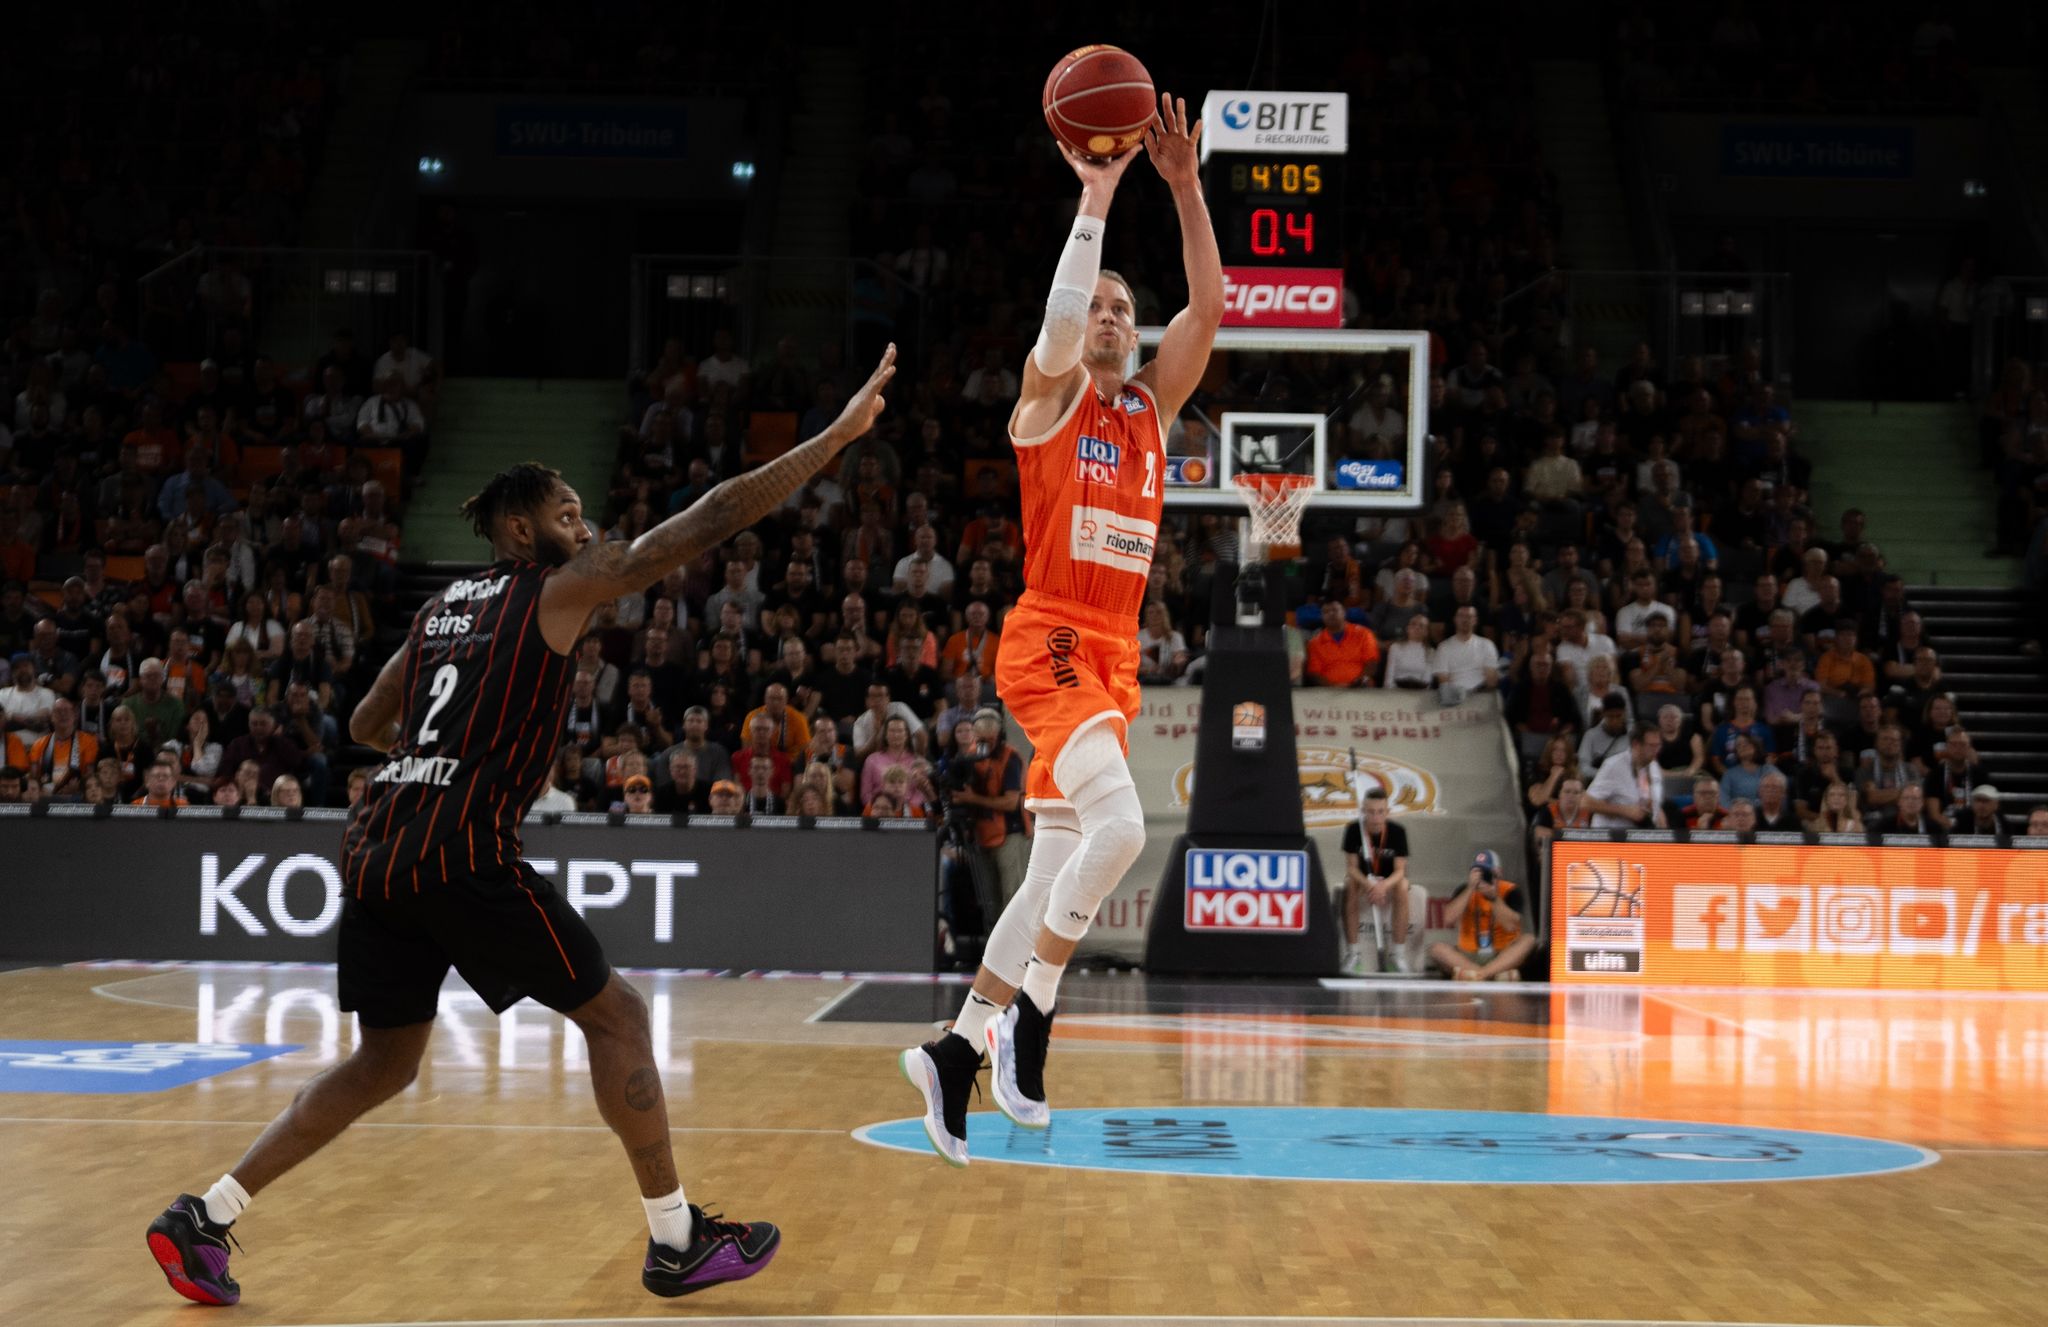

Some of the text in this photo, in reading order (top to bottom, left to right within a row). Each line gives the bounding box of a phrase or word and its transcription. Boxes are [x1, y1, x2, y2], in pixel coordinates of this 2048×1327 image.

[1256, 102, 1330, 131] BITE
[509, 118, 674, 147] SWU-Tribüne
[1254, 133, 1331, 145] E-RECRUITING
[1733, 140, 1901, 168] SWU-Tribüne
[1251, 208, 1314, 255] 0.4
[1356, 472, 1398, 486] Credit
[425, 609, 473, 636] eins
[418, 664, 458, 745] 2
[1303, 708, 1426, 721] wünscht
[1192, 854, 1300, 889] LIQUI
[1191, 891, 1302, 926] MOLY
[1584, 950, 1627, 971] ulm
